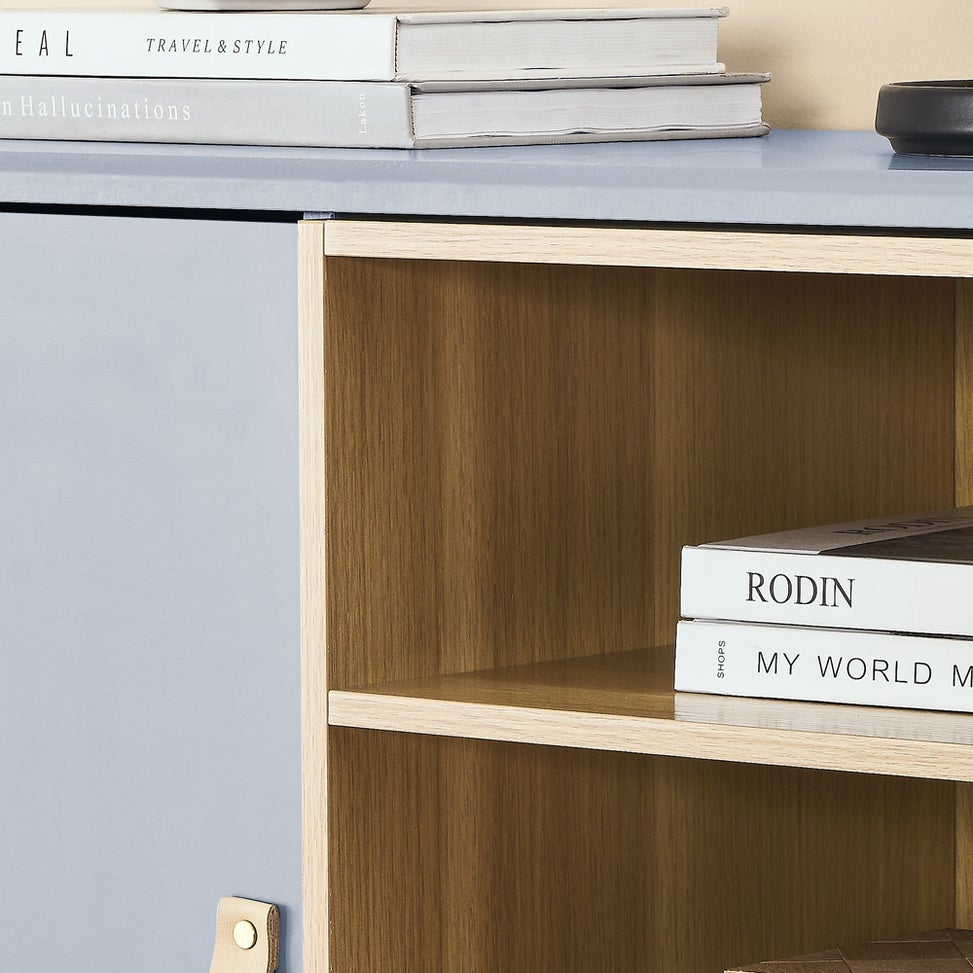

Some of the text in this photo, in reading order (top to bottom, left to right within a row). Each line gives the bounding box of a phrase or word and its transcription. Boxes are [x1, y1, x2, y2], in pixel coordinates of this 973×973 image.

[19, 95, 191, 120] Hallucinations
[745, 571, 856, 609] RODIN
[716, 640, 726, 679] SHOPS
[757, 651, 801, 676] MY
[817, 655, 932, 685] WORLD
